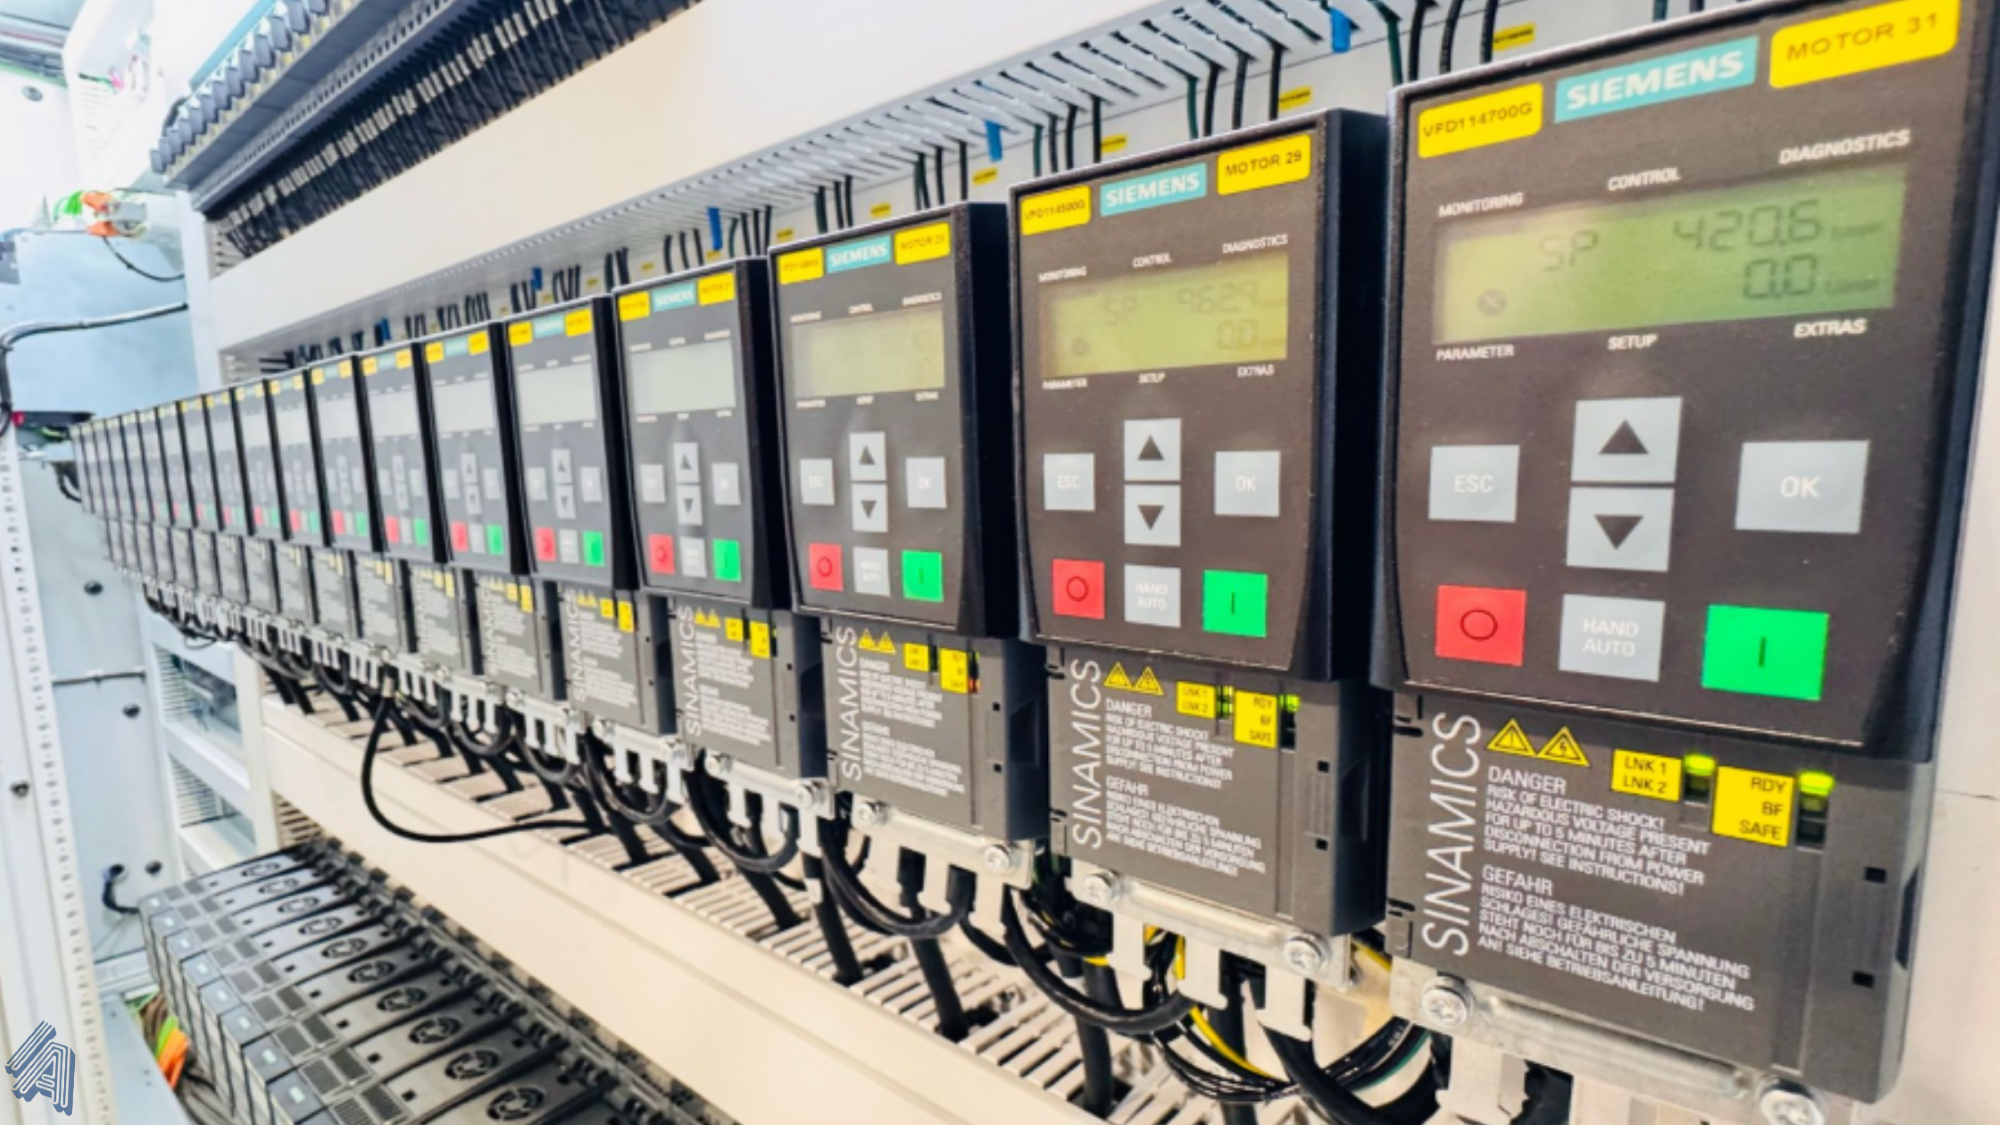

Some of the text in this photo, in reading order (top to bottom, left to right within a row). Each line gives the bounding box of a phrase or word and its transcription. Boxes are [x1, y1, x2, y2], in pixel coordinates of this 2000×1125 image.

[1786, 12, 1938, 62] MOTOR 31
[1565, 50, 1744, 111] SIEMENS
[1422, 101, 1534, 139] VFD114700G
[1778, 128, 1912, 166] DIAGNOSTICS
[1225, 149, 1302, 178] MOTOR 29
[1106, 171, 1200, 208] SIEMENS
[1607, 167, 1681, 192] CONTROL
[1438, 192, 1524, 218] MONITORING
[831, 243, 887, 267] SIEMENS
[1222, 233, 1288, 254] DIAGNOSTICS
[1537, 230, 1599, 272] SP
[1132, 252, 1172, 268] CONTROL
[1793, 317, 1867, 339] EXTRAS
[1436, 344, 1514, 362] PARAMETER
[1607, 333, 1658, 352] SETUP
[1057, 475, 1081, 490] ESC
[1235, 475, 1257, 492] OK
[1453, 472, 1494, 494] ESC
[1780, 475, 1821, 499] OK
[1135, 583, 1168, 596] HAND
[1136, 596, 1167, 611] AUTO
[1582, 617, 1639, 639] HAND
[1582, 636, 1636, 659] AUTO
[677, 605, 701, 736] SINAMICS
[836, 626, 862, 781] SINAMICS
[1106, 698, 1152, 719] DANGER
[1071, 659, 1102, 848] SINAMICS
[1624, 756, 1667, 774] LNK 1
[1106, 774, 1148, 797] GEFAHR
[1488, 766, 1567, 796] DANGER
[1622, 775, 1668, 794] LNK 2
[1751, 776, 1788, 795] RDY
[1487, 784, 1666, 832] RISK OF ELECTRIC SHOCK!
[1762, 802, 1784, 816] BF
[1422, 712, 1481, 956] SINAMICS
[1486, 797, 1711, 856] HAZARDOUS VOLTAGE PRESENT
[1486, 810, 1510, 827] FOR
[1512, 815, 1532, 831] UP
[1535, 822, 1553, 837] TO
[1567, 829, 1636, 854] MINUTES
[1638, 844, 1688, 866] AFTER
[1740, 820, 1782, 840] SAFE
[1484, 824, 1705, 886] DISCONNECTION FROM POWER
[1540, 850, 1565, 868] SEE
[1482, 864, 1553, 897] GEFAHR
[1526, 894, 1567, 915] EINES
[1479, 908, 1519, 931] STEHT
[1522, 920, 1563, 942] NOCH
[1658, 958, 1737, 991] MINUTEN
[1505, 943, 1543, 966] SIEHE
[1658, 942, 1750, 980] SPANNUNG
[1478, 921, 1517, 943] NACH
[1610, 959, 1642, 978] DER
[1644, 968, 1755, 1012] VERSORGUNG
